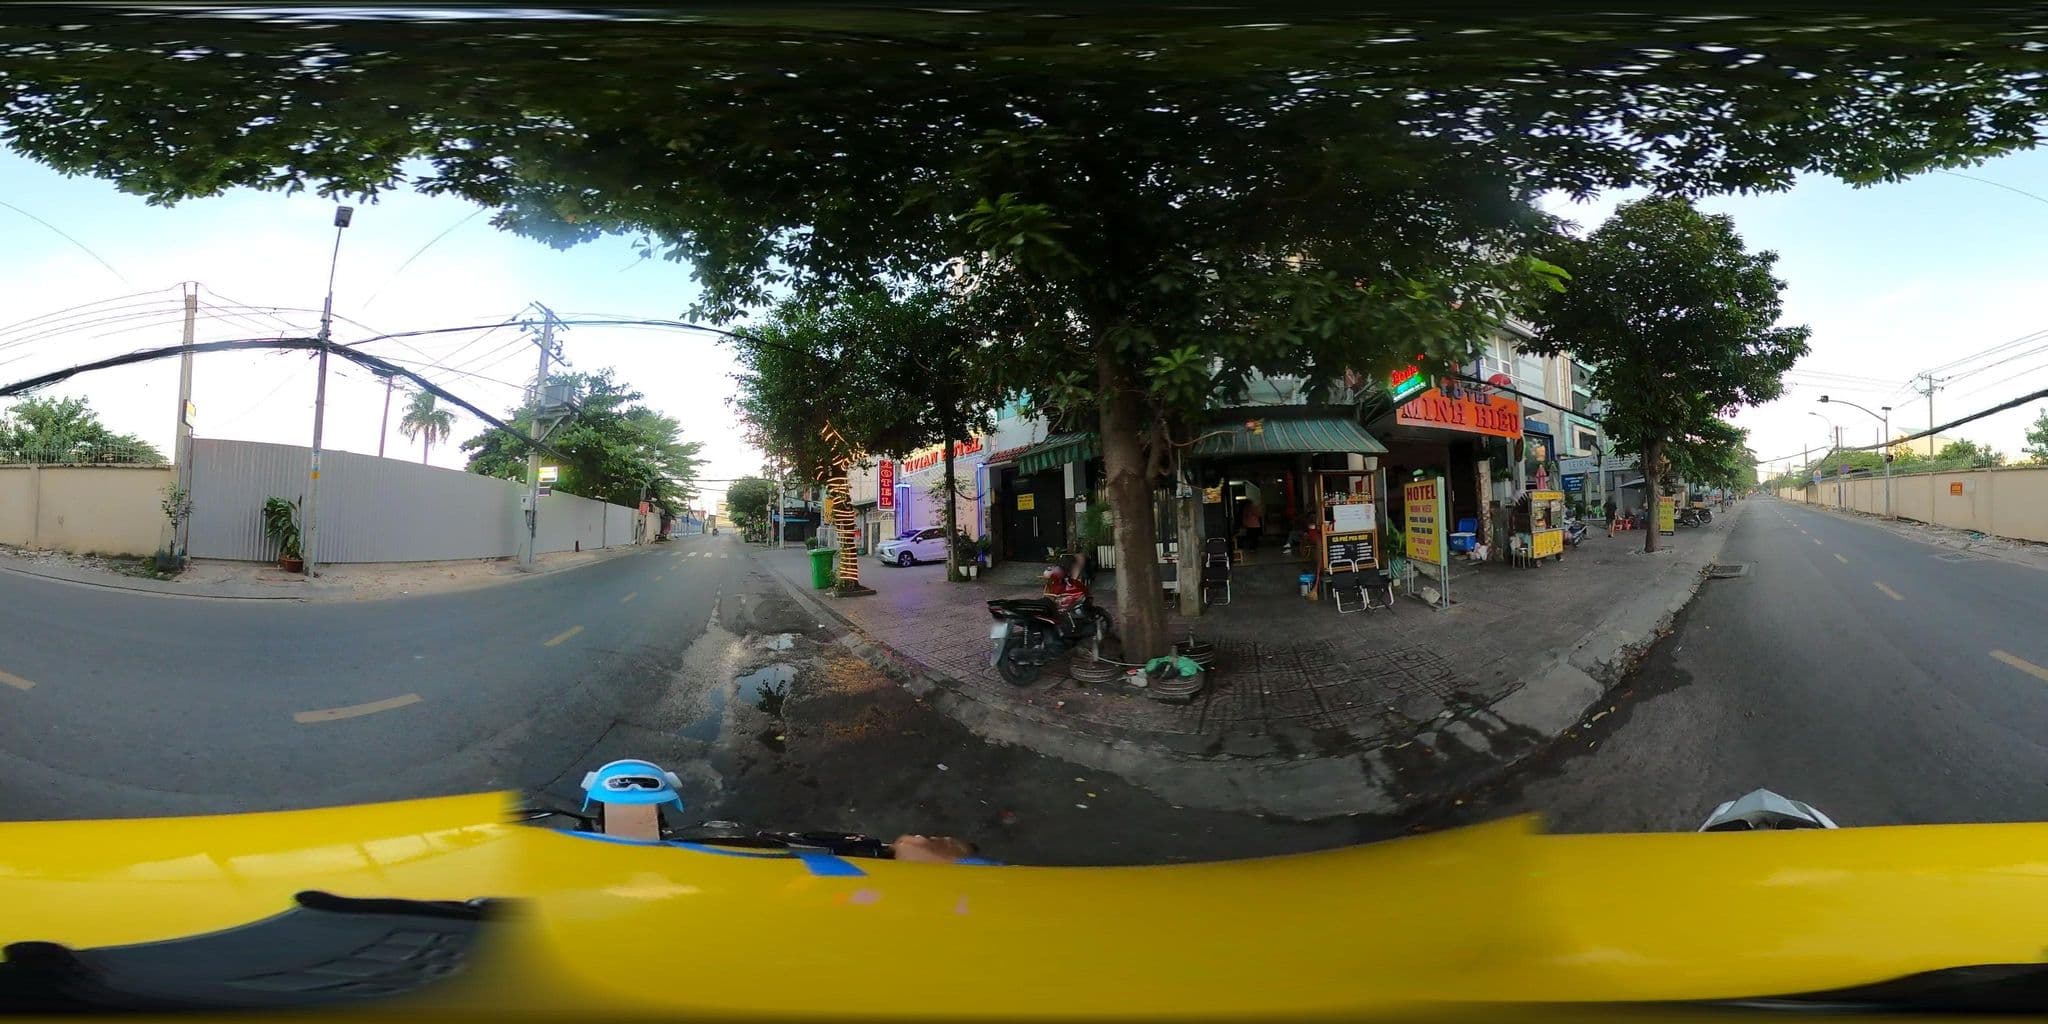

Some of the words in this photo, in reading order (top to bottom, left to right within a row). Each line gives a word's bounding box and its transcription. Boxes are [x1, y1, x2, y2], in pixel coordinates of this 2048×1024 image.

[1401, 398, 1466, 425] MINH
[904, 451, 938, 473] VIVIAN
[880, 460, 893, 506] HOTEL
[1407, 484, 1436, 500] HOTEL
